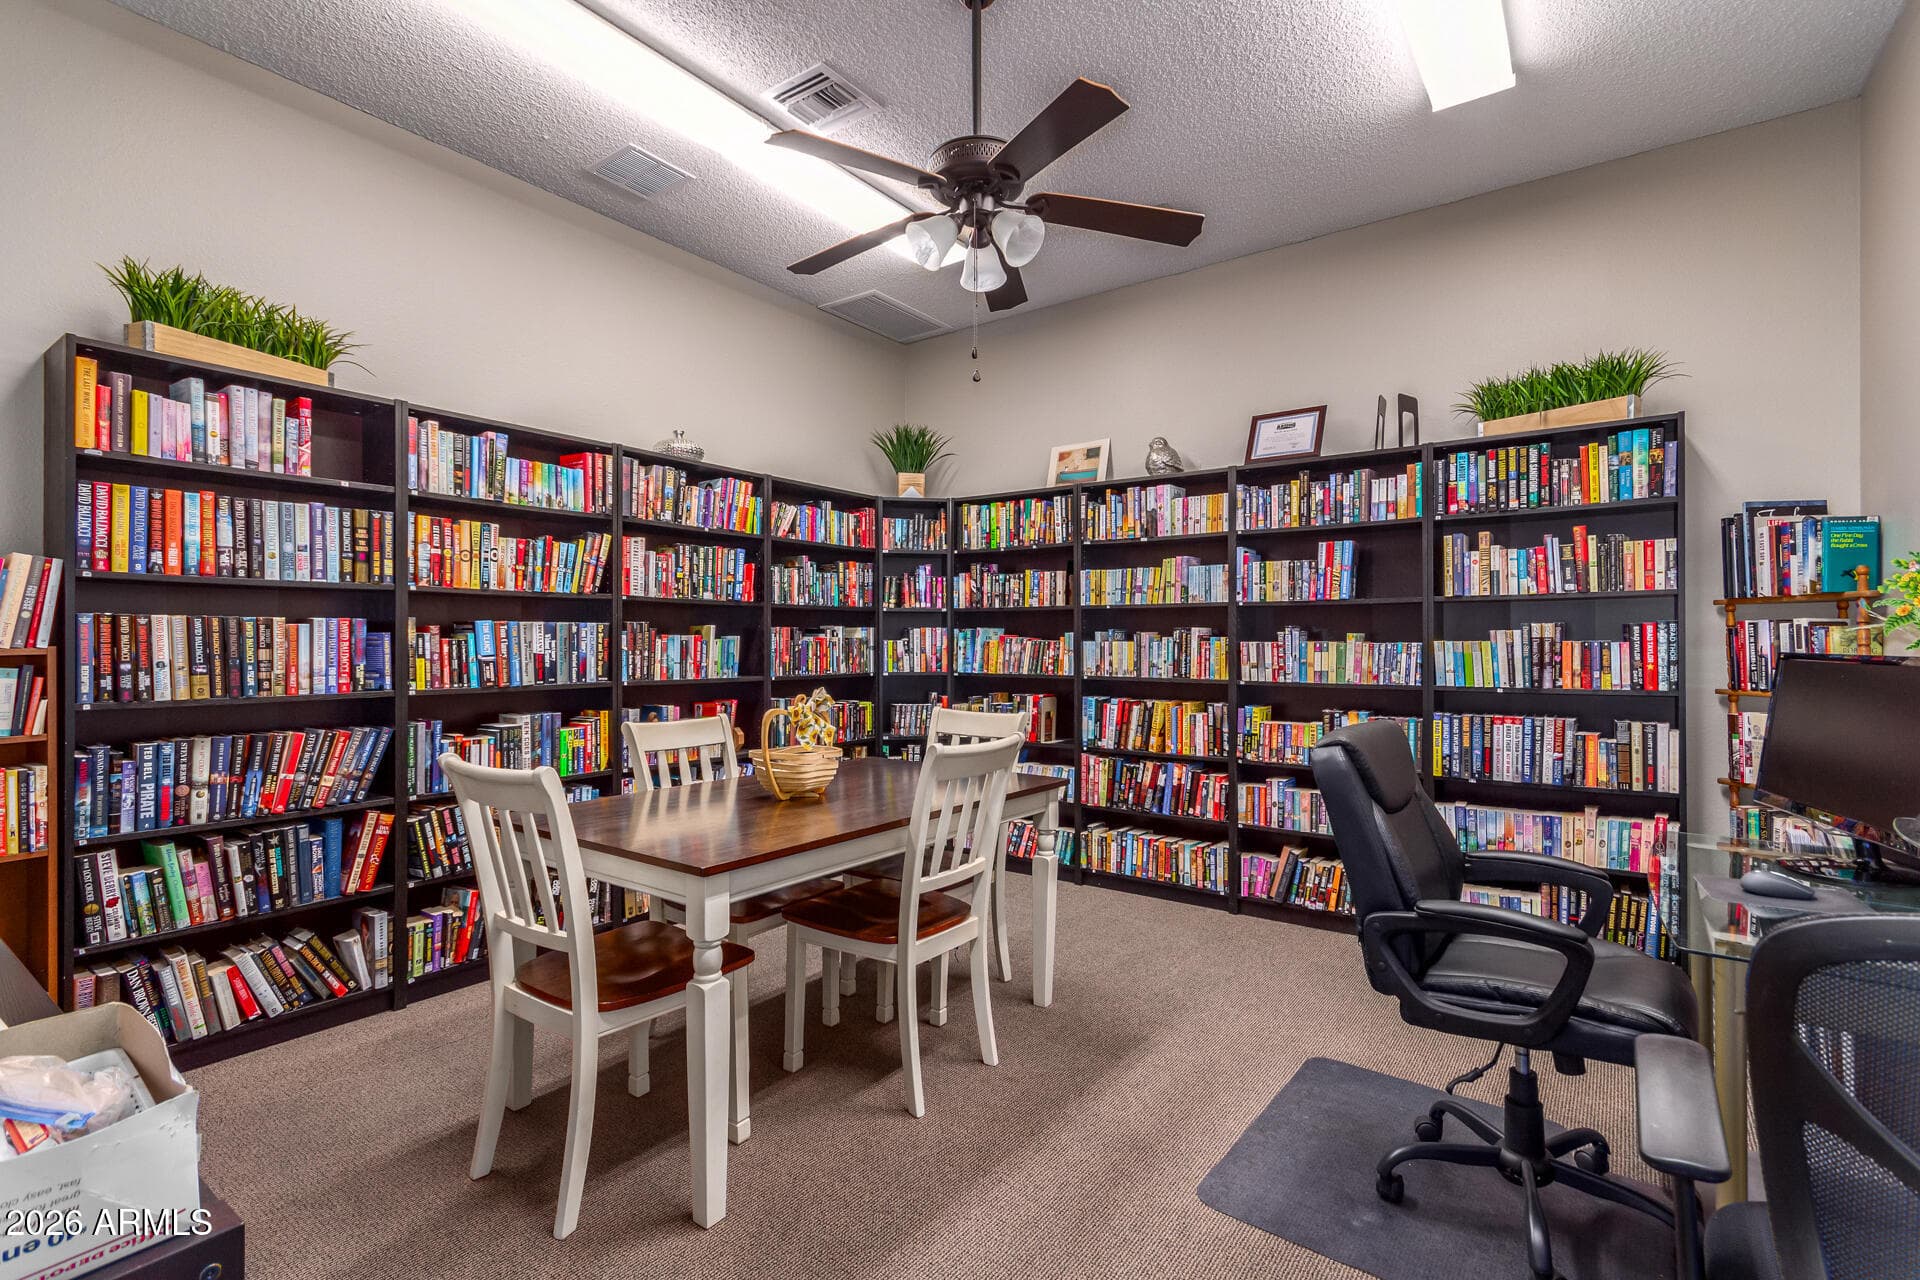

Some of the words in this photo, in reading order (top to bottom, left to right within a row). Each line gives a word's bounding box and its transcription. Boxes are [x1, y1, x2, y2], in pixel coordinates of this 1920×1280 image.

[1530, 448, 1538, 462] JOHN
[1529, 464, 1538, 492] SANDFORD
[78, 484, 92, 503] DAVID
[96, 486, 107, 507] DAVID
[135, 489, 146, 508] DAVID
[151, 500, 162, 516] DAVID
[236, 501, 246, 520] DAVID
[78, 505, 92, 537] BALDACCI
[96, 508, 107, 547] BALDACCI
[134, 510, 144, 541] BALDACCI
[151, 518, 162, 550] BALDACCI
[237, 522, 247, 548] BALDACCI
[169, 548, 178, 566] FALLEN
[1480, 548, 1490, 563] HILL
[1480, 564, 1490, 585] TOWNS
[100, 624, 110, 642] DAVID
[340, 621, 349, 640] DAVID
[101, 644, 111, 673] BALDACCI
[195, 636, 203, 663] BALDACCI
[341, 642, 349, 672] BALDACCI
[274, 736, 282, 752] STEVE
[305, 734, 316, 752] STEVE
[144, 762, 152, 780] BELL
[271, 753, 280, 772] BERRY
[301, 752, 312, 772] BERRY
[140, 784, 154, 818] PIRATE
[373, 836, 387, 856] ANGELS
[101, 854, 114, 874] STEVE
[370, 855, 380, 865] &
[83, 870, 92, 884] LOST
[366, 864, 376, 883] DEMONS
[84, 884, 95, 902] ORDER
[104, 875, 116, 898] BERRY
[85, 917, 95, 933] BERRY
[92, 916, 101, 931] STEVE
[126, 970, 140, 989] DAN
[176, 960, 190, 980] SANDRA
[79, 979, 92, 989] DAN
[182, 980, 194, 999] BROWN
[131, 989, 150, 1014] BROWN
[2, 1239, 40, 1262] en
